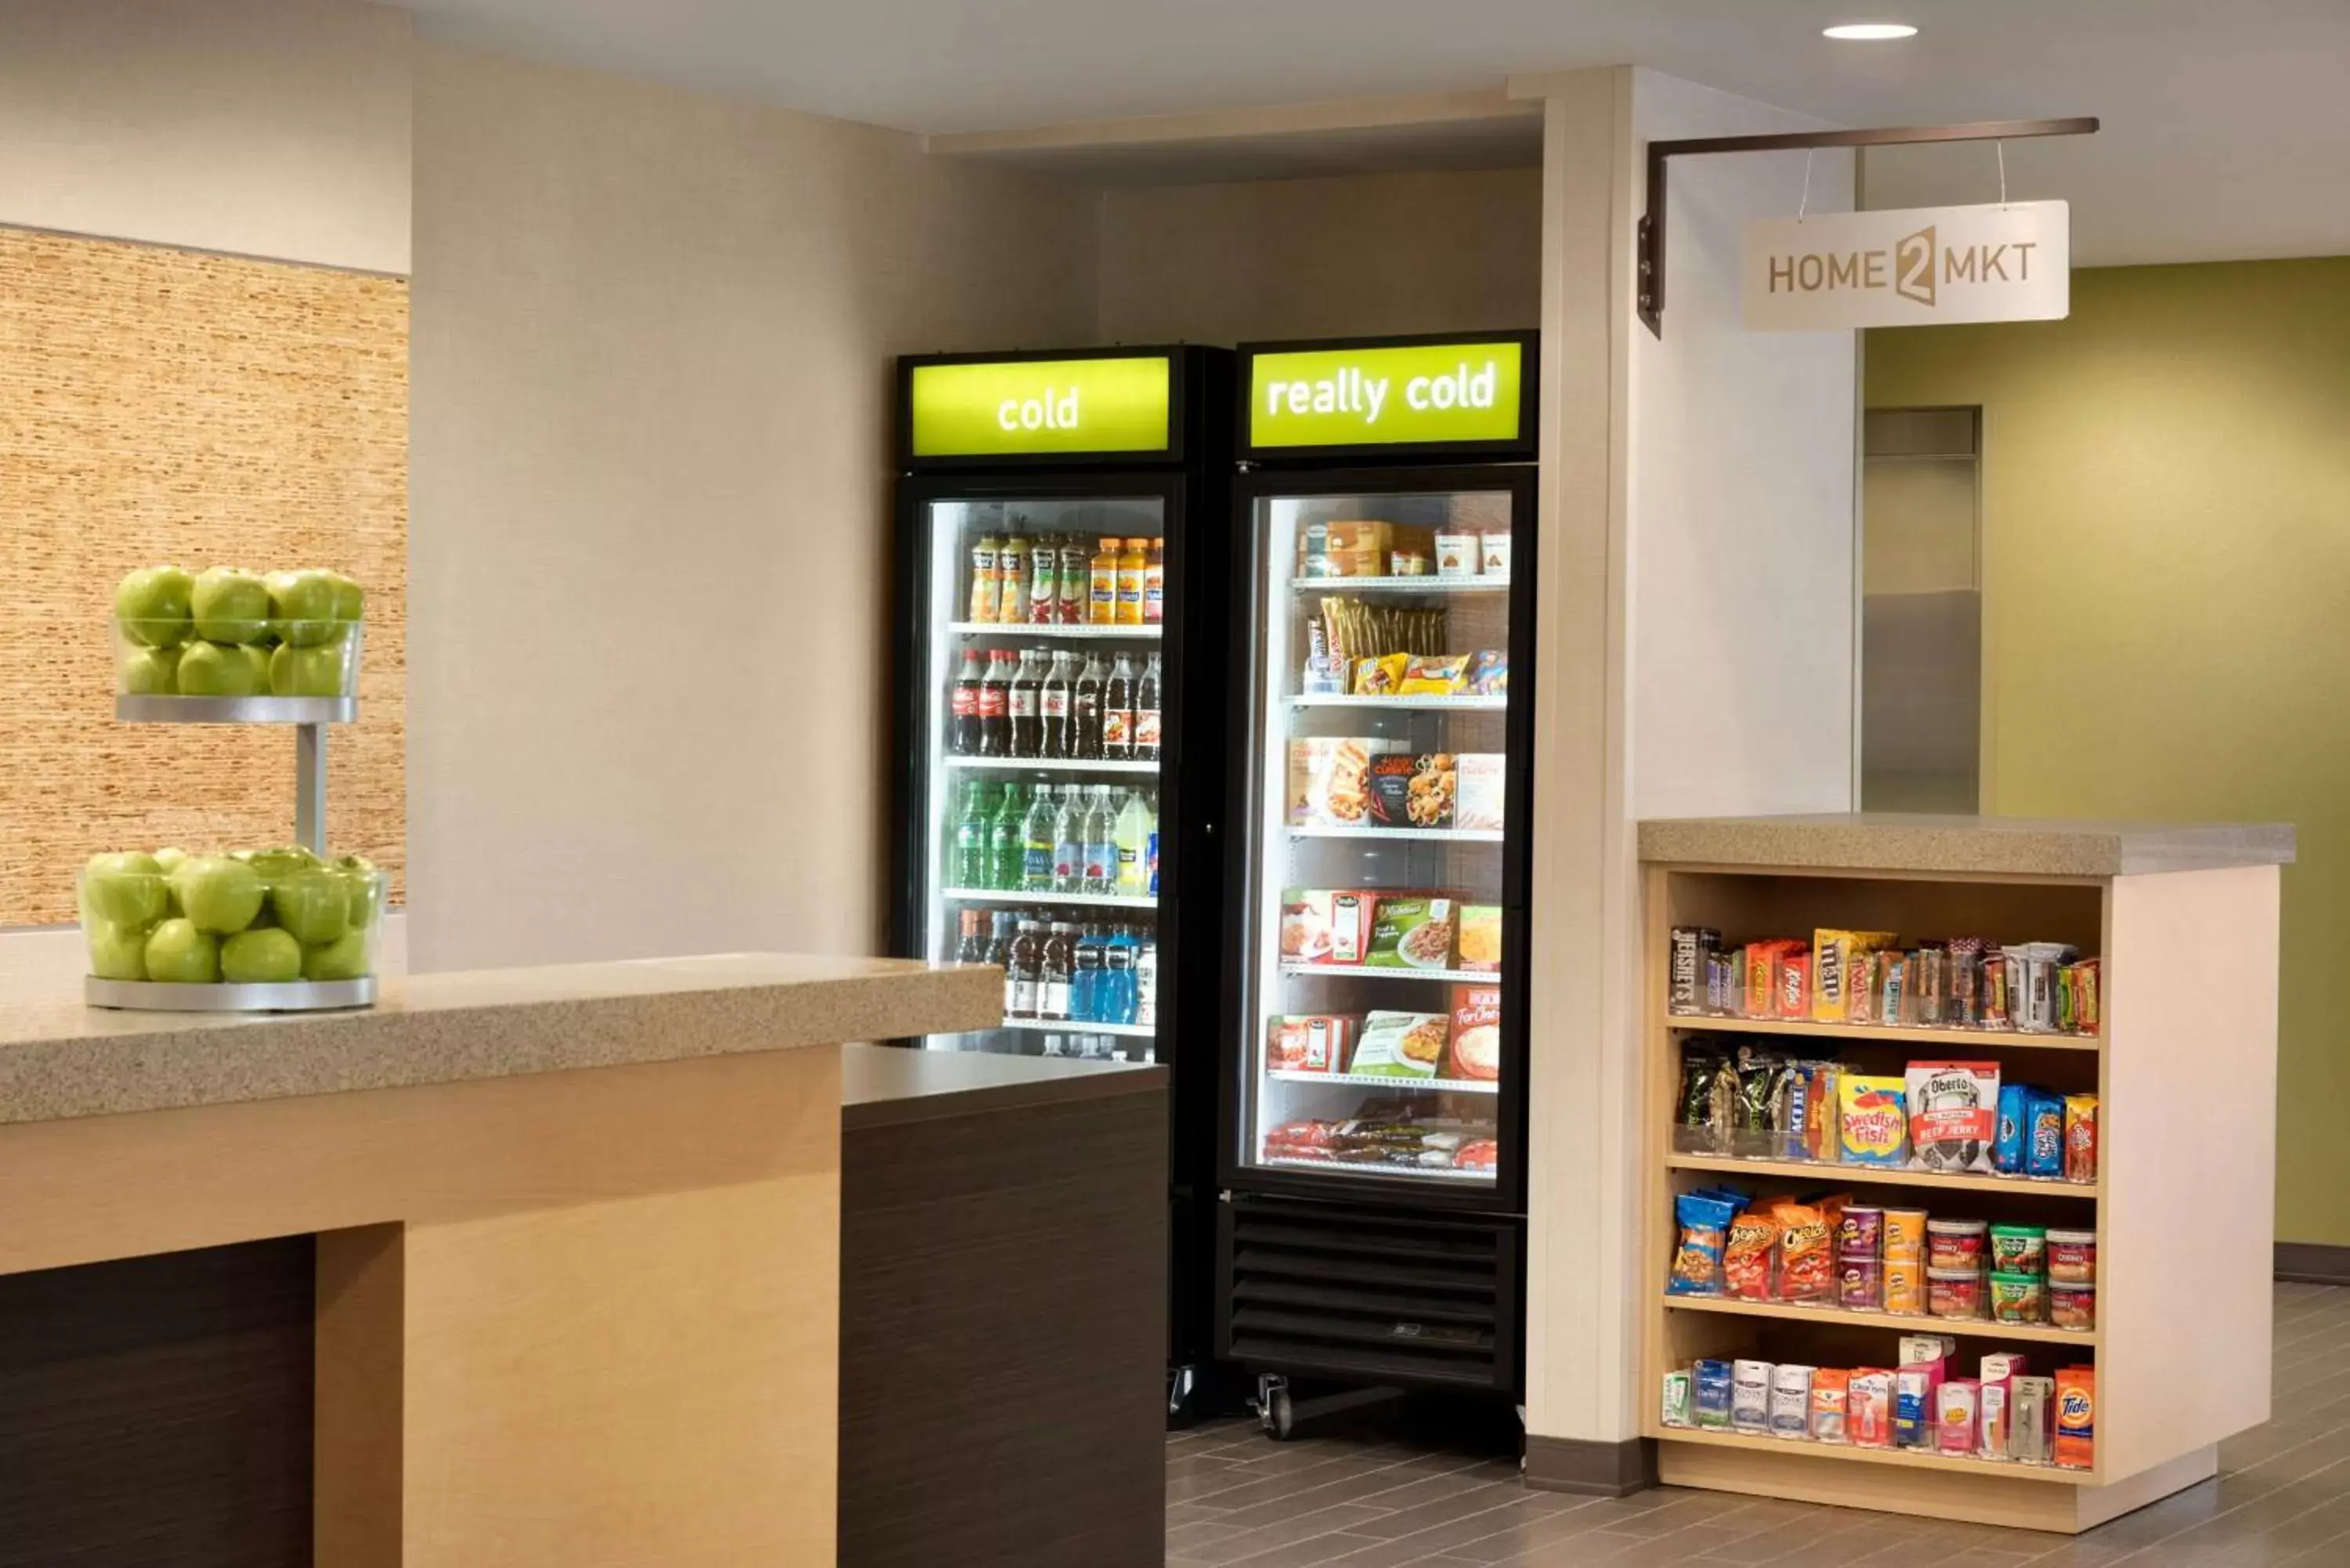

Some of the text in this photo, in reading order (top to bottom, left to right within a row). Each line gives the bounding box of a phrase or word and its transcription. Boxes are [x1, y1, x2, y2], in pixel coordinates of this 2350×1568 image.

[1769, 250, 1888, 294] HOME
[1944, 242, 2037, 284] MKT
[1267, 359, 1495, 424] really cold
[998, 386, 1079, 431] cold
[1931, 1078, 1969, 1095] Oberto
[1844, 1111, 1901, 1132] Swedish
[1920, 1125, 1979, 1139] BEEF JERKY
[1855, 1125, 1889, 1145] Fish
[2062, 1395, 2090, 1417] Tide
